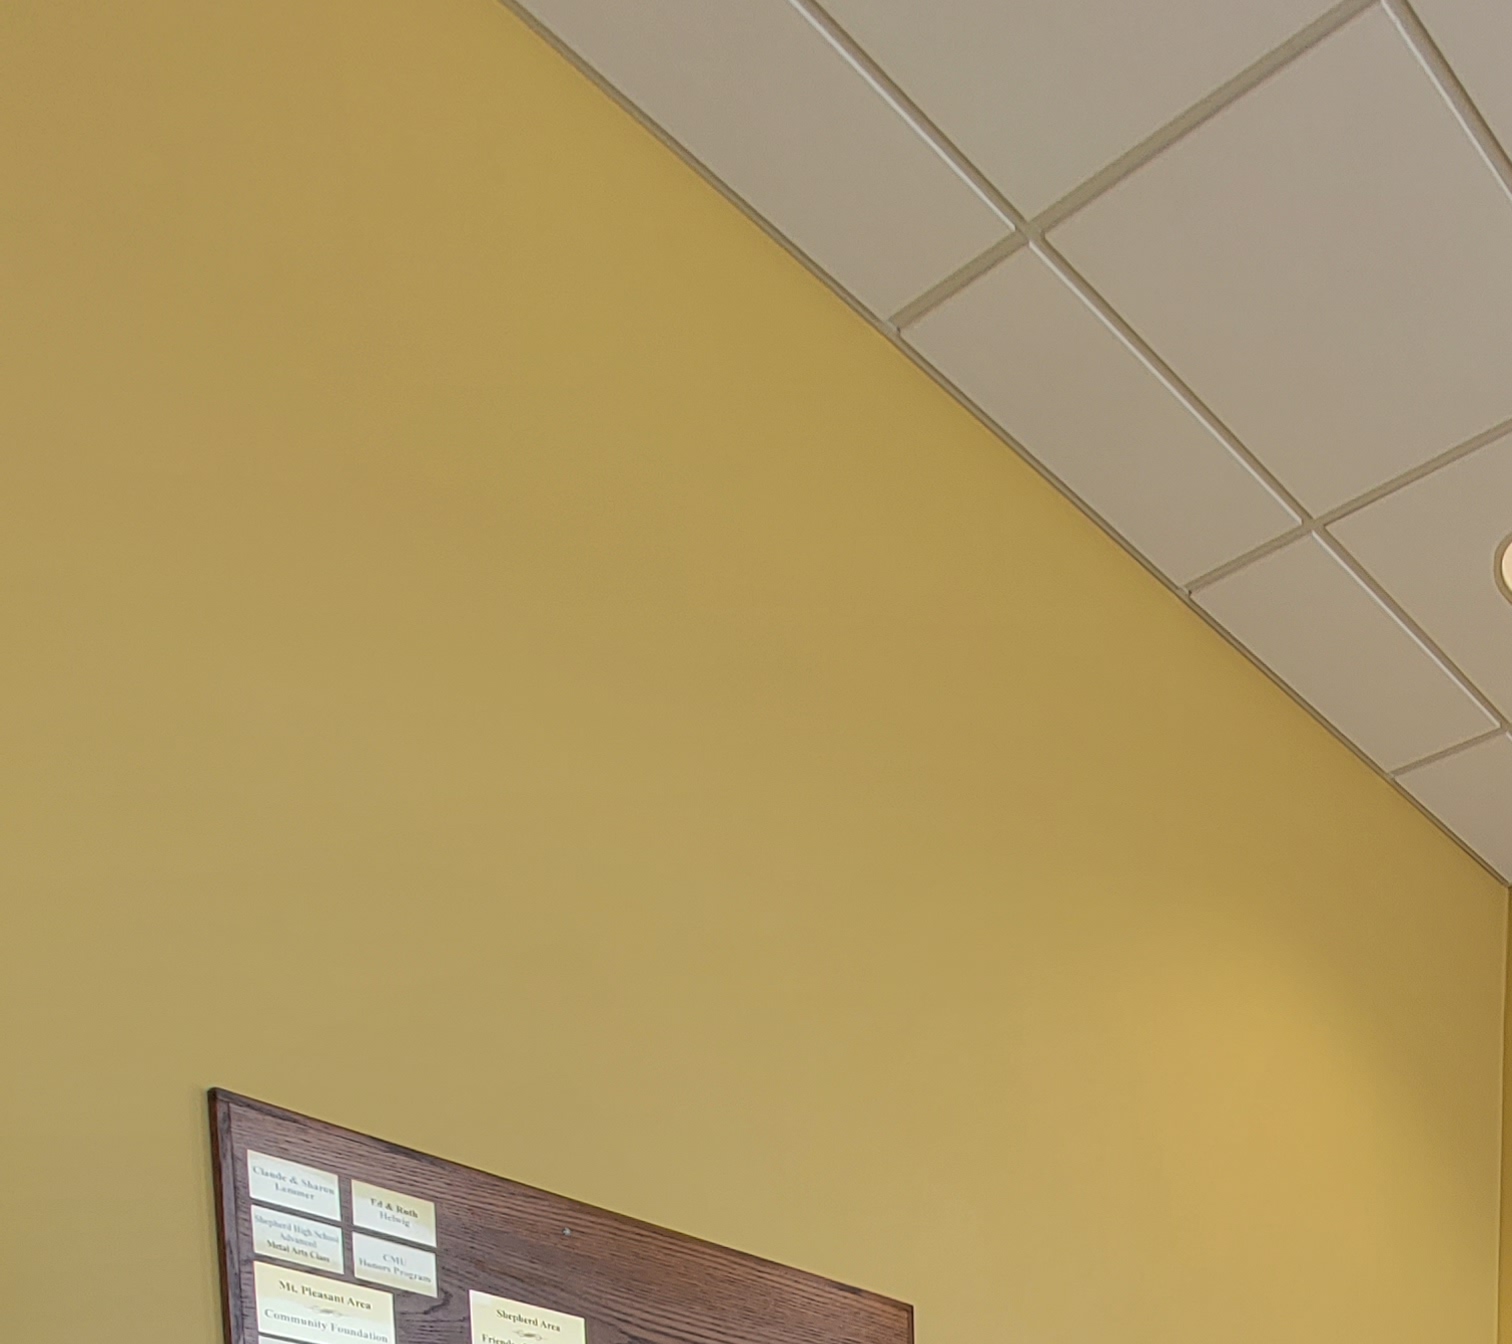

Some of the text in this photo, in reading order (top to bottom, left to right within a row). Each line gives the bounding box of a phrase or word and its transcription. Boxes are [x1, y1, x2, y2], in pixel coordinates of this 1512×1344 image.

[385, 1202, 393, 1211] &
[396, 1204, 418, 1219] Ruth
[255, 1215, 292, 1232] Shepherd
[294, 1226, 313, 1237] High
[267, 1240, 330, 1263] Metal Arts Class
[393, 1266, 432, 1283] Program
[278, 1281, 371, 1310] Mt. Pleasant Area
[264, 1309, 389, 1343] Community Foundation
[496, 1309, 561, 1332] Shepherd Area
